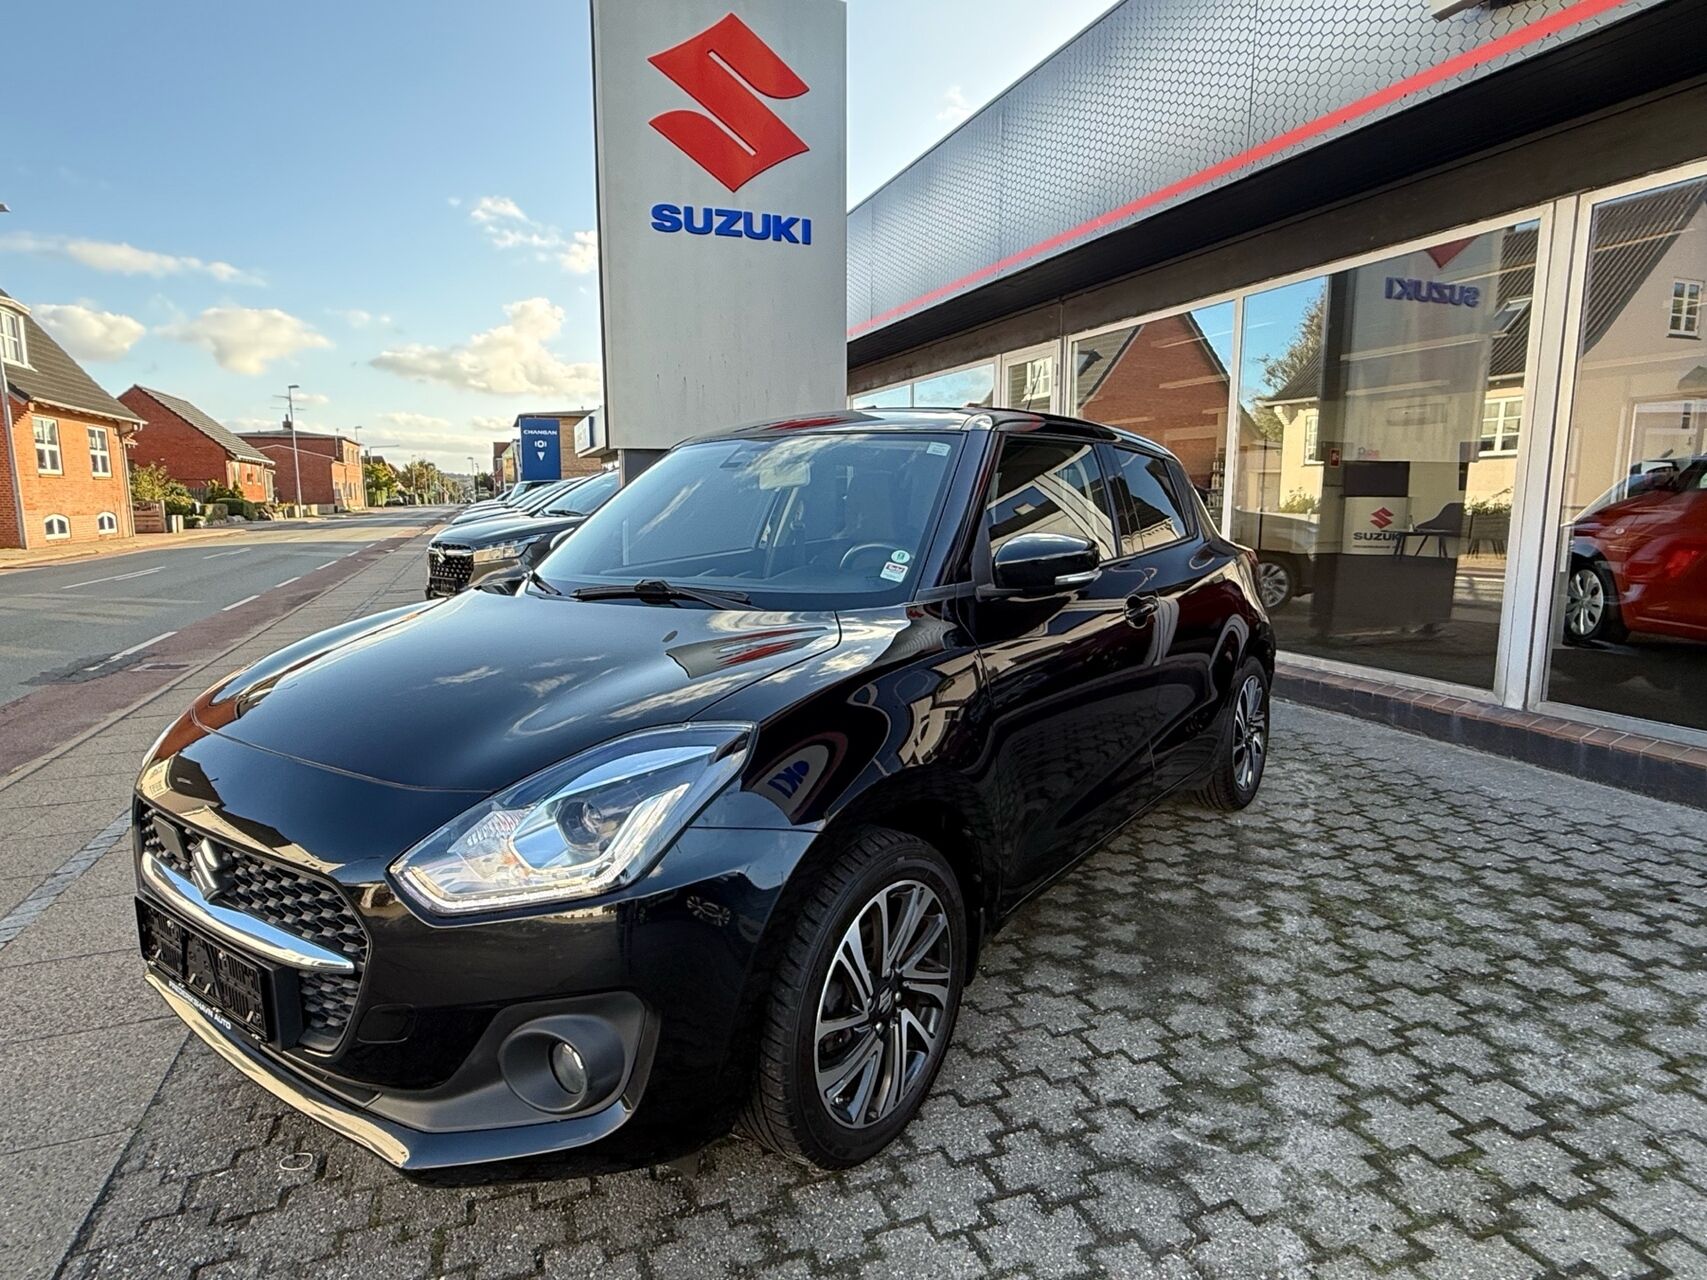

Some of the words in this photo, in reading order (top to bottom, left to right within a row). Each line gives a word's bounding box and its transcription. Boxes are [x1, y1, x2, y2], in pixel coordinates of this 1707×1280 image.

[651, 203, 812, 246] SUZUKI
[1353, 531, 1401, 541] SUZUK
[214, 1013, 232, 1030] AUTO
